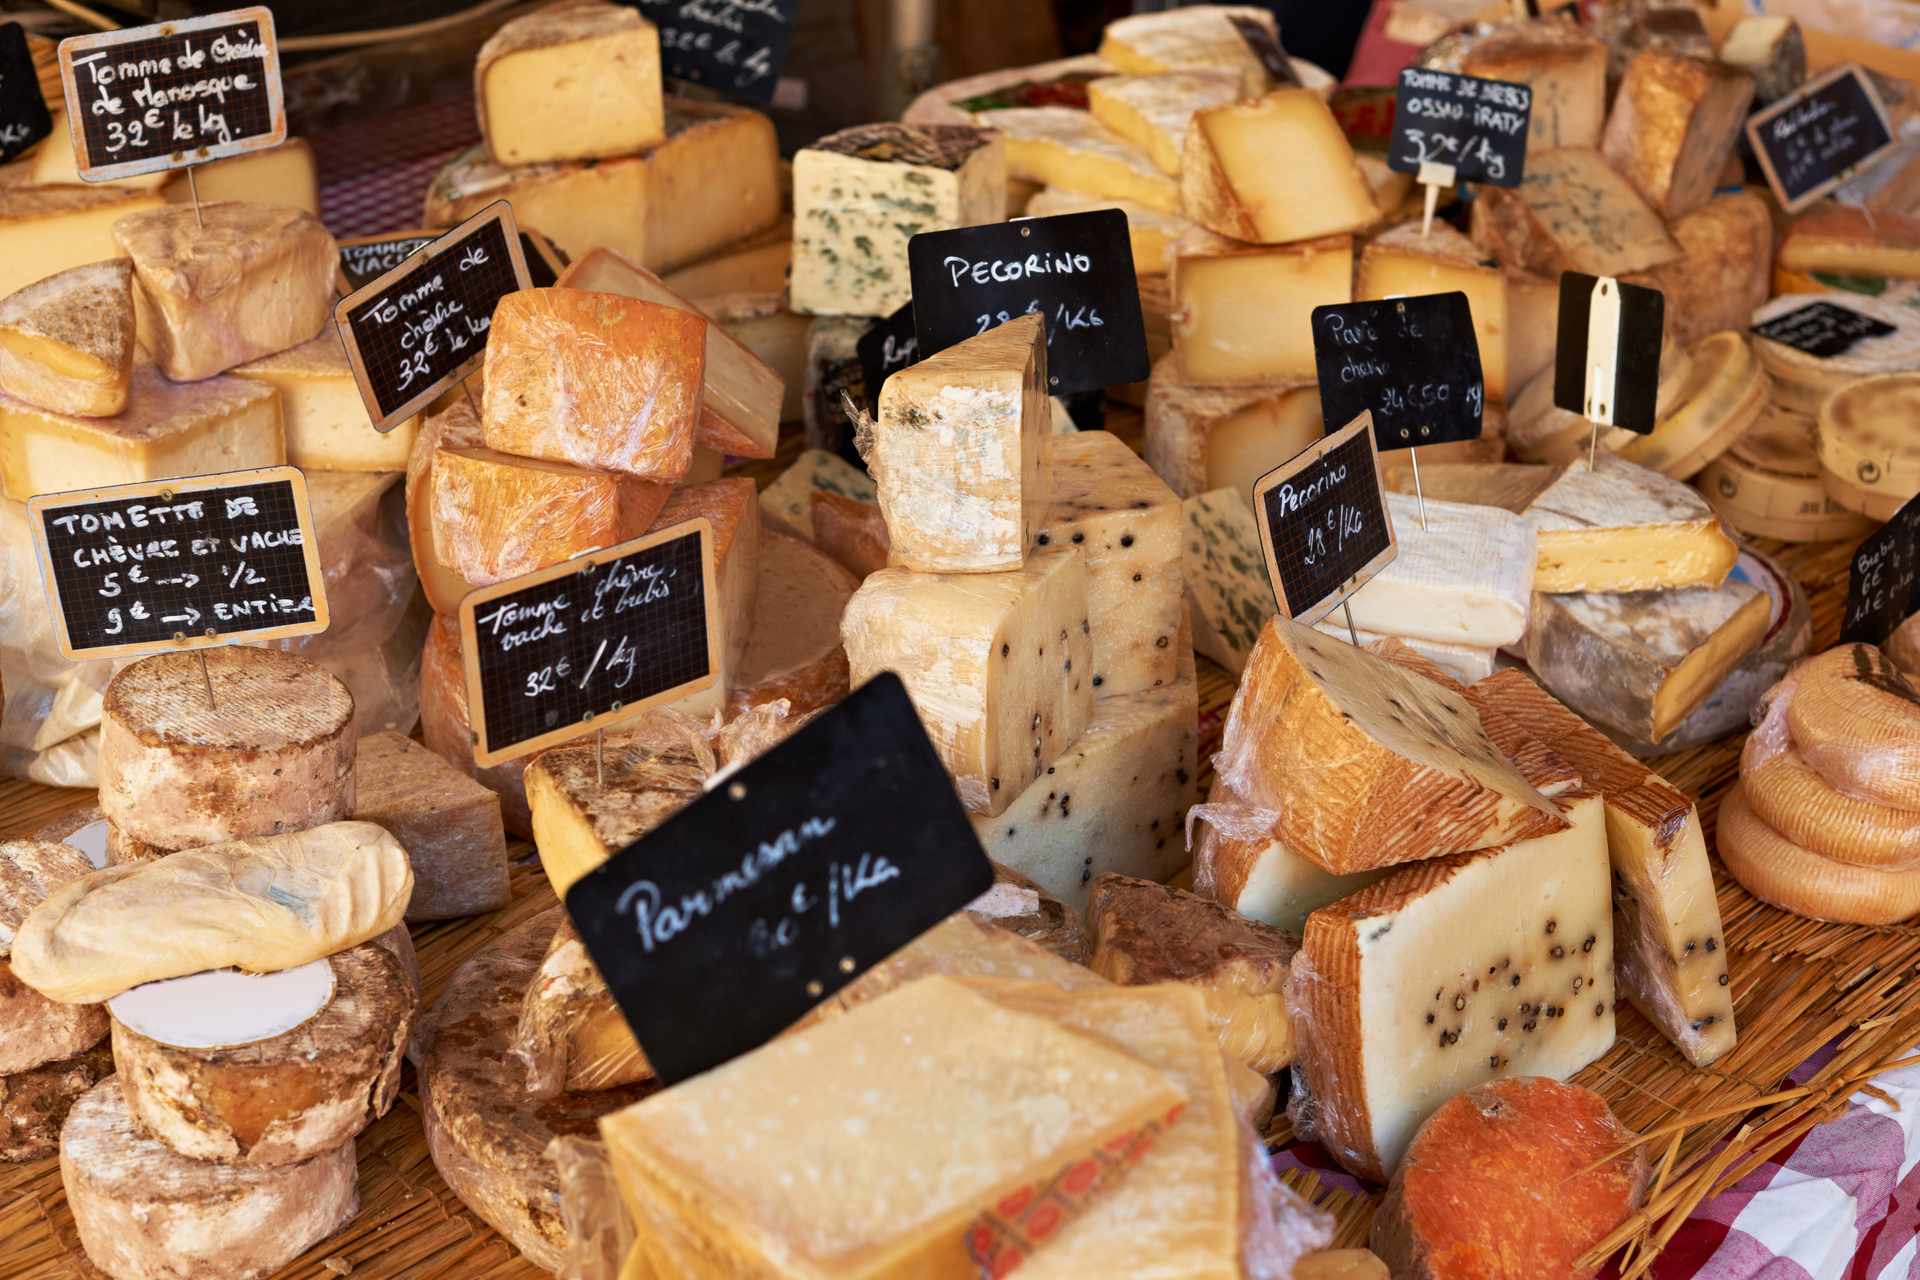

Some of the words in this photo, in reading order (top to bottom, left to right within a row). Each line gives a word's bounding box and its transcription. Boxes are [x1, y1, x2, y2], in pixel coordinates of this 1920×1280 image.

[72, 51, 172, 85] Tomme
[177, 39, 206, 70] de
[91, 85, 125, 116] de
[105, 108, 164, 152] 32€
[173, 110, 194, 141] le
[357, 275, 444, 324] Tomme
[459, 246, 490, 271] de
[397, 332, 439, 391] 32€
[225, 496, 259, 519] DE
[1279, 462, 1347, 517] Pecorino
[191, 537, 221, 556] ET
[229, 528, 305, 553] VACHE
[478, 594, 571, 634] Tomme
[501, 612, 568, 650] vache
[615, 574, 669, 613] brebis
[616, 816, 836, 953] Parmesan
